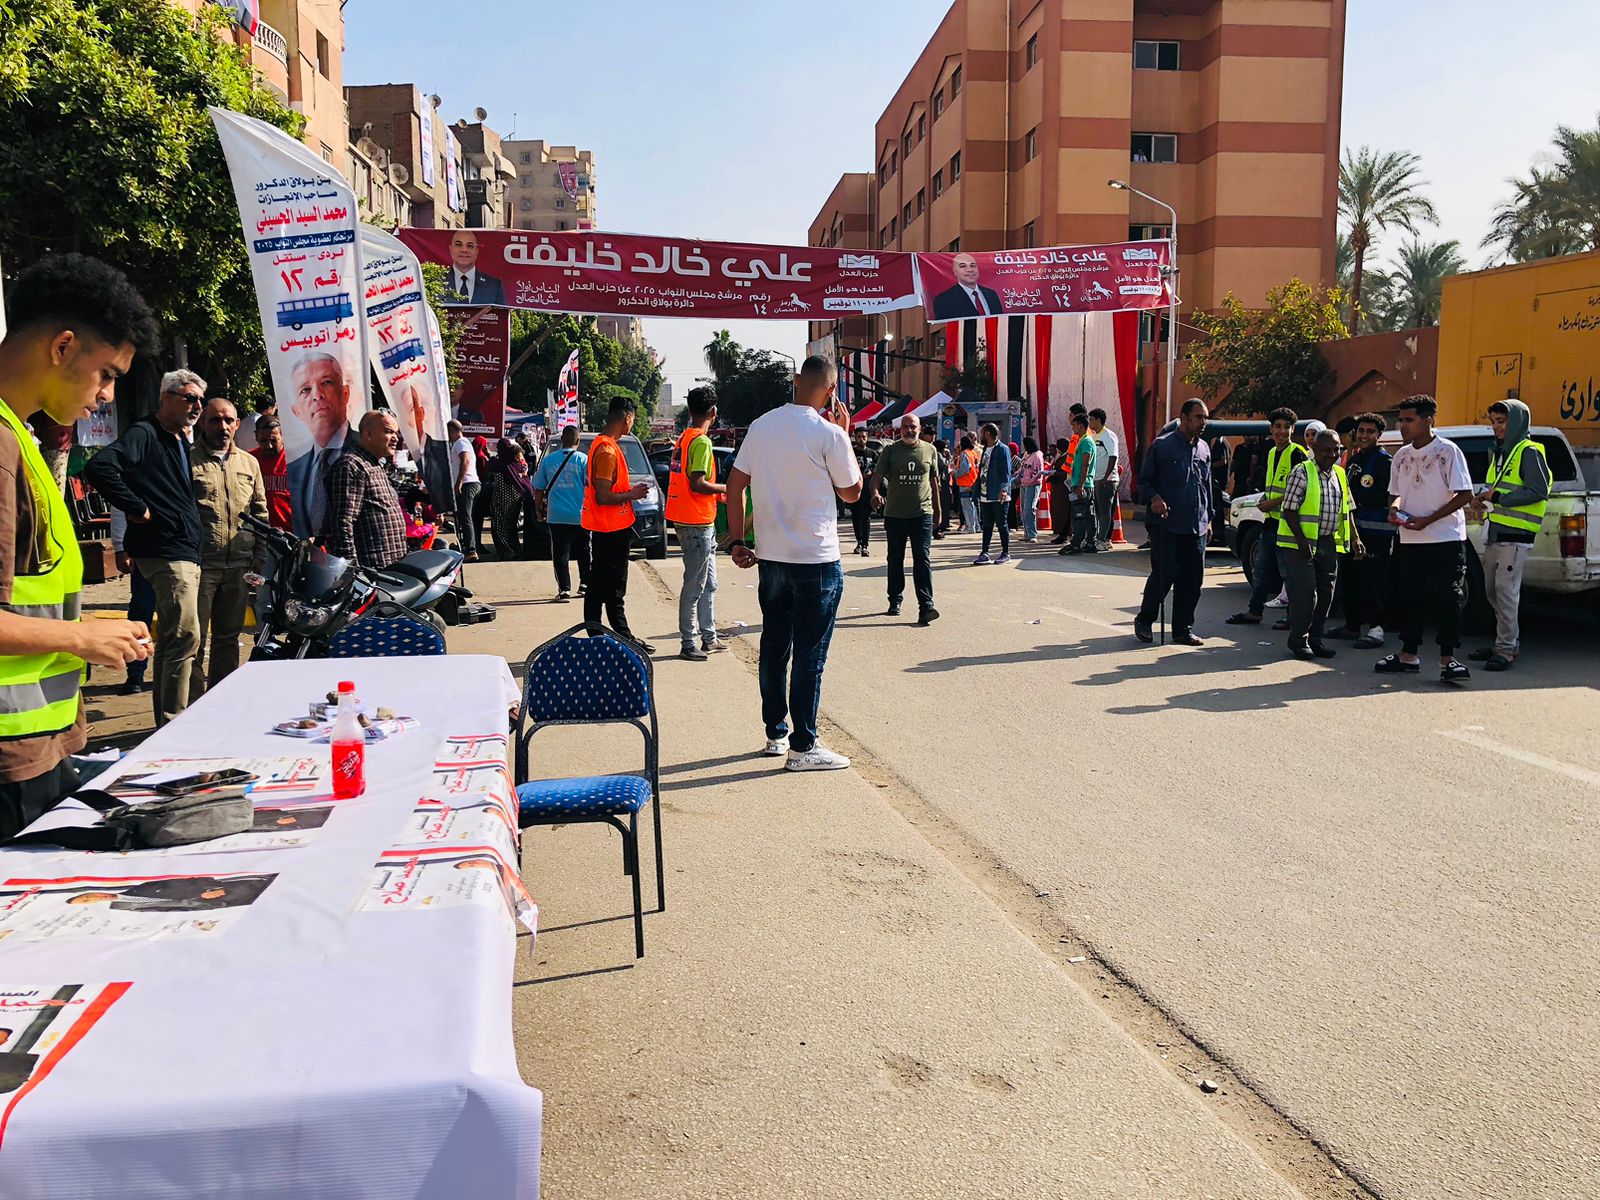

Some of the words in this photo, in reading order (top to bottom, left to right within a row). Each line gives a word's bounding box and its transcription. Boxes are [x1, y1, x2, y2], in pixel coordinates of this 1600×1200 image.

[255, 178, 289, 191] الدكرور
[289, 177, 315, 188] بولاق
[303, 191, 338, 201] صاحب
[296, 204, 322, 227] السيد
[324, 206, 347, 220] محمد
[257, 207, 294, 235] الحسيني
[274, 238, 293, 248] النواب
[293, 239, 310, 248] مجلس
[272, 253, 307, 265] مستقل
[503, 235, 622, 276] خليفة
[994, 252, 1037, 267] خليفة
[1041, 251, 1069, 264] خالد
[1072, 250, 1107, 265] علي
[631, 245, 710, 277] خالد
[721, 253, 812, 287] علي
[281, 268, 303, 293] ١٢
[315, 269, 341, 290] رقم
[1115, 274, 1132, 283] الأمل
[1144, 275, 1161, 283] لعدل
[568, 281, 595, 291] العدل
[596, 283, 617, 293] حزب
[618, 285, 631, 293] عن
[635, 286, 654, 294] ٢٠٢٥
[825, 284, 844, 294] الأمل
[860, 285, 884, 293] العدل
[1051, 283, 1071, 292] رقم
[658, 288, 685, 297] النواب
[686, 289, 716, 299] مجلس
[718, 290, 742, 300] مرشح
[749, 292, 771, 302] رقم
[617, 297, 649, 306] الدكرور
[650, 298, 673, 308] بولاق
[674, 299, 694, 308] دائرة
[827, 299, 852, 308] نوفمبر
[1054, 293, 1071, 308] ١٤
[753, 303, 767, 315] ١٤
[333, 325, 356, 343] رمز
[377, 325, 395, 344] ١٢
[470, 354, 500, 365] علي
